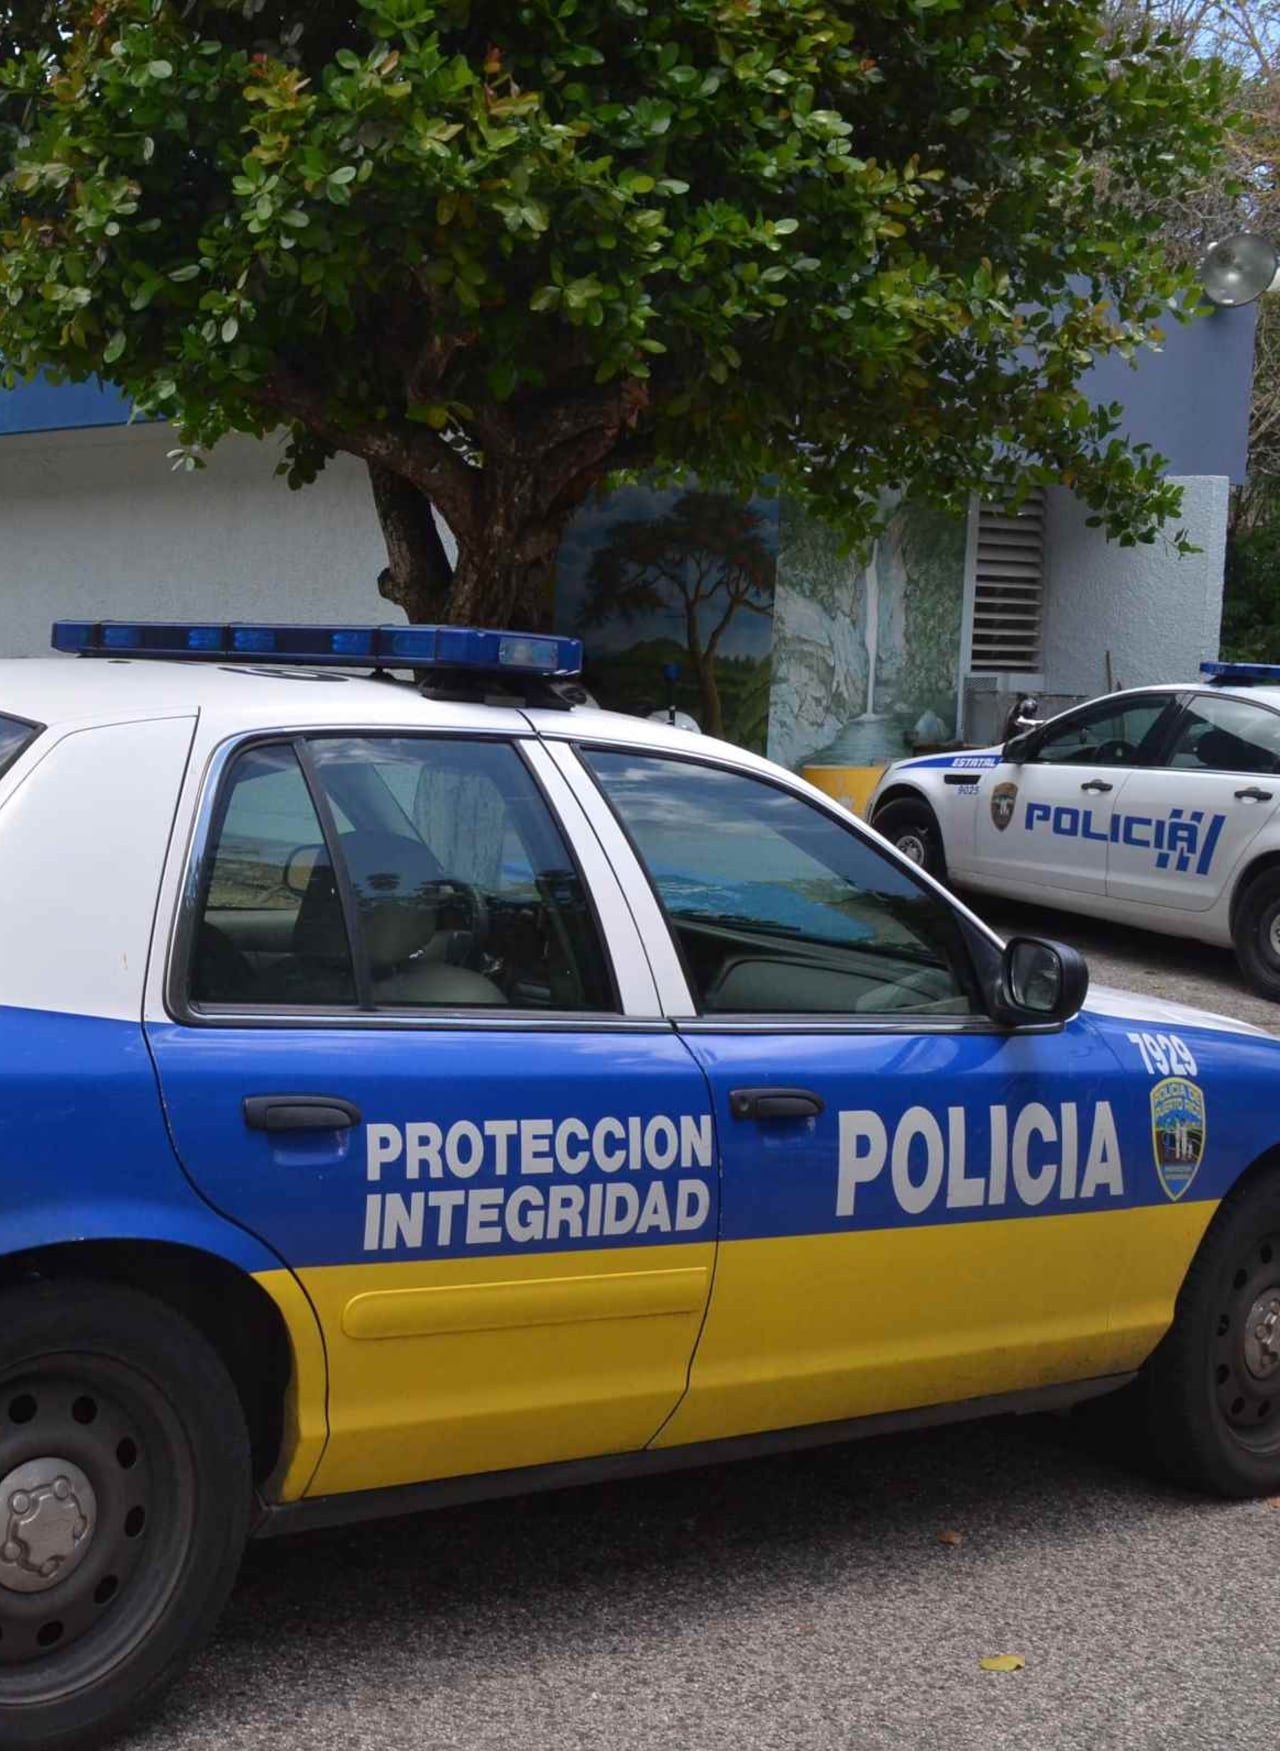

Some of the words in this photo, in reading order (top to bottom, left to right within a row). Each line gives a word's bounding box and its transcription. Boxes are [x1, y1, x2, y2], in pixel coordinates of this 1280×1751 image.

[951, 757, 997, 769] ESTATAL
[1024, 802, 1201, 858] POLICIA
[1126, 1032, 1199, 1076] 7929
[366, 1114, 713, 1181] PROTECCION
[835, 1100, 1125, 1217] POLICIA
[363, 1178, 711, 1250] INTEGRIDAD
